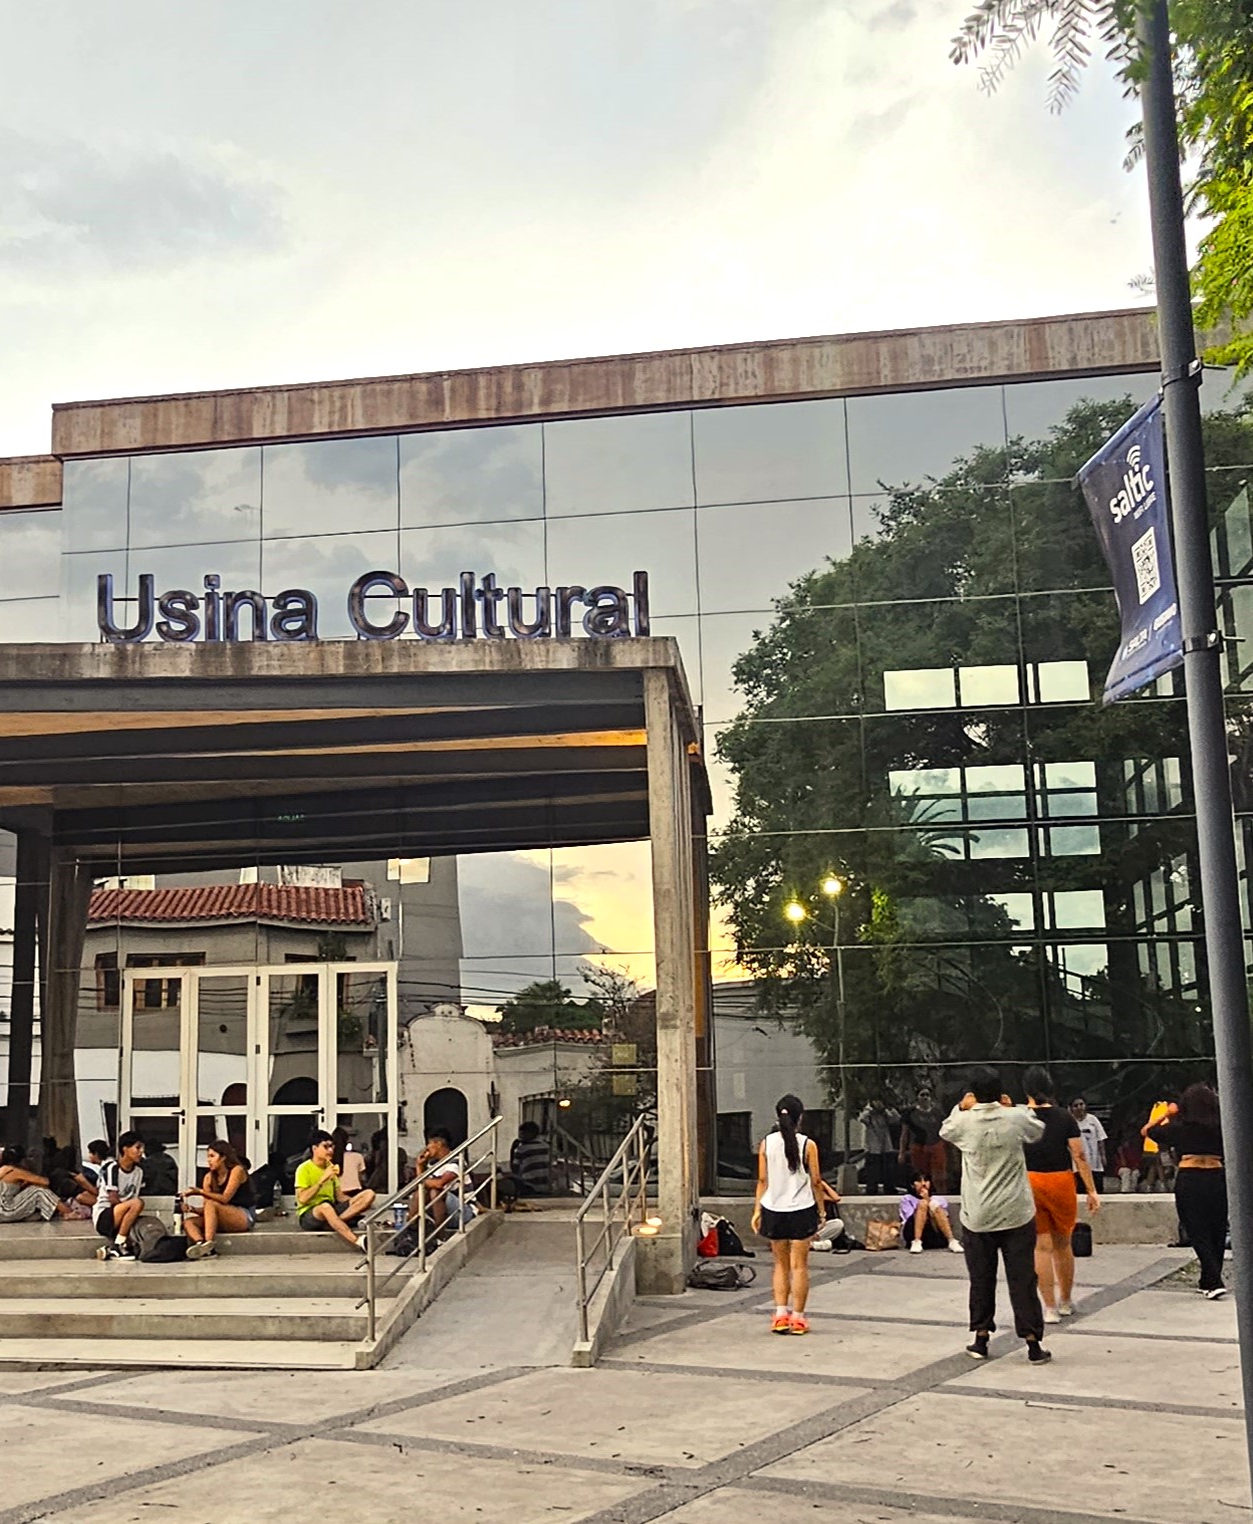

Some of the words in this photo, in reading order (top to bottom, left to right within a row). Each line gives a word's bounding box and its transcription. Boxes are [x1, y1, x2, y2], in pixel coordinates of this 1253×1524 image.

[1109, 463, 1154, 524] saltic
[97, 573, 318, 642] Usina
[347, 570, 649, 641] Cultural
